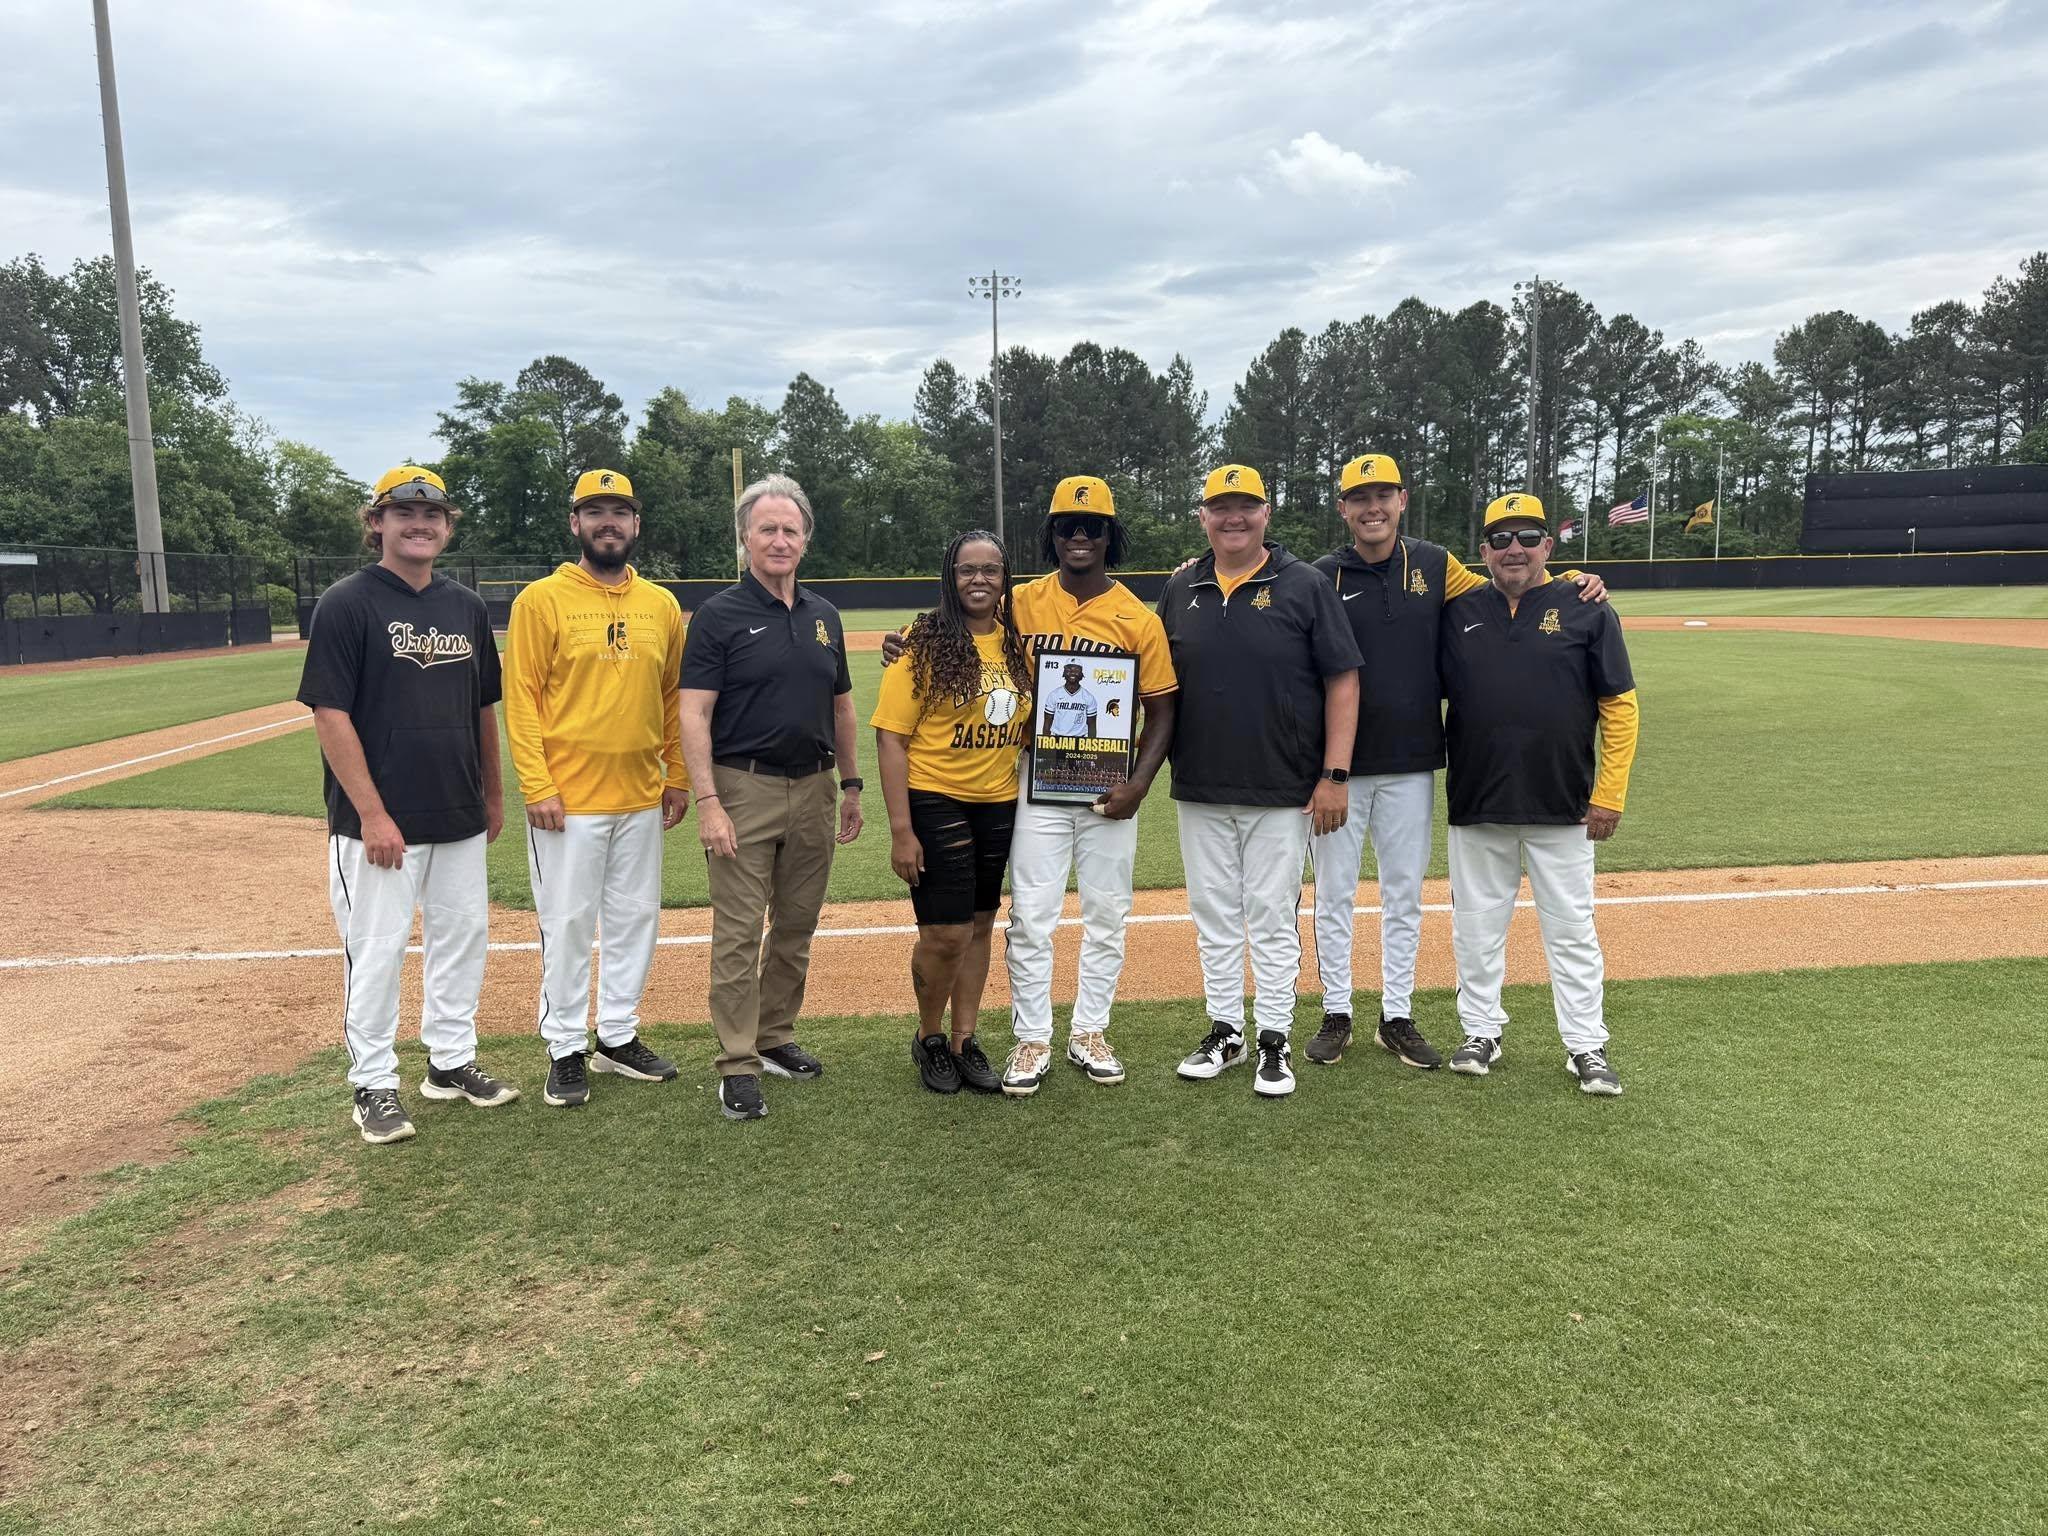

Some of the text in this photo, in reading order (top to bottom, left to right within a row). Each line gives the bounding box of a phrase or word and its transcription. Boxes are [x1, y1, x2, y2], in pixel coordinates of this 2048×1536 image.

[388, 621, 472, 664] Trojans
[1021, 634, 1126, 656] TROJA
[1045, 660, 1059, 669] #13
[950, 721, 1023, 749] BASEBL
[1037, 735, 1128, 753] TROJAN BASEBALL
[1065, 752, 1098, 760] 2024-2025
